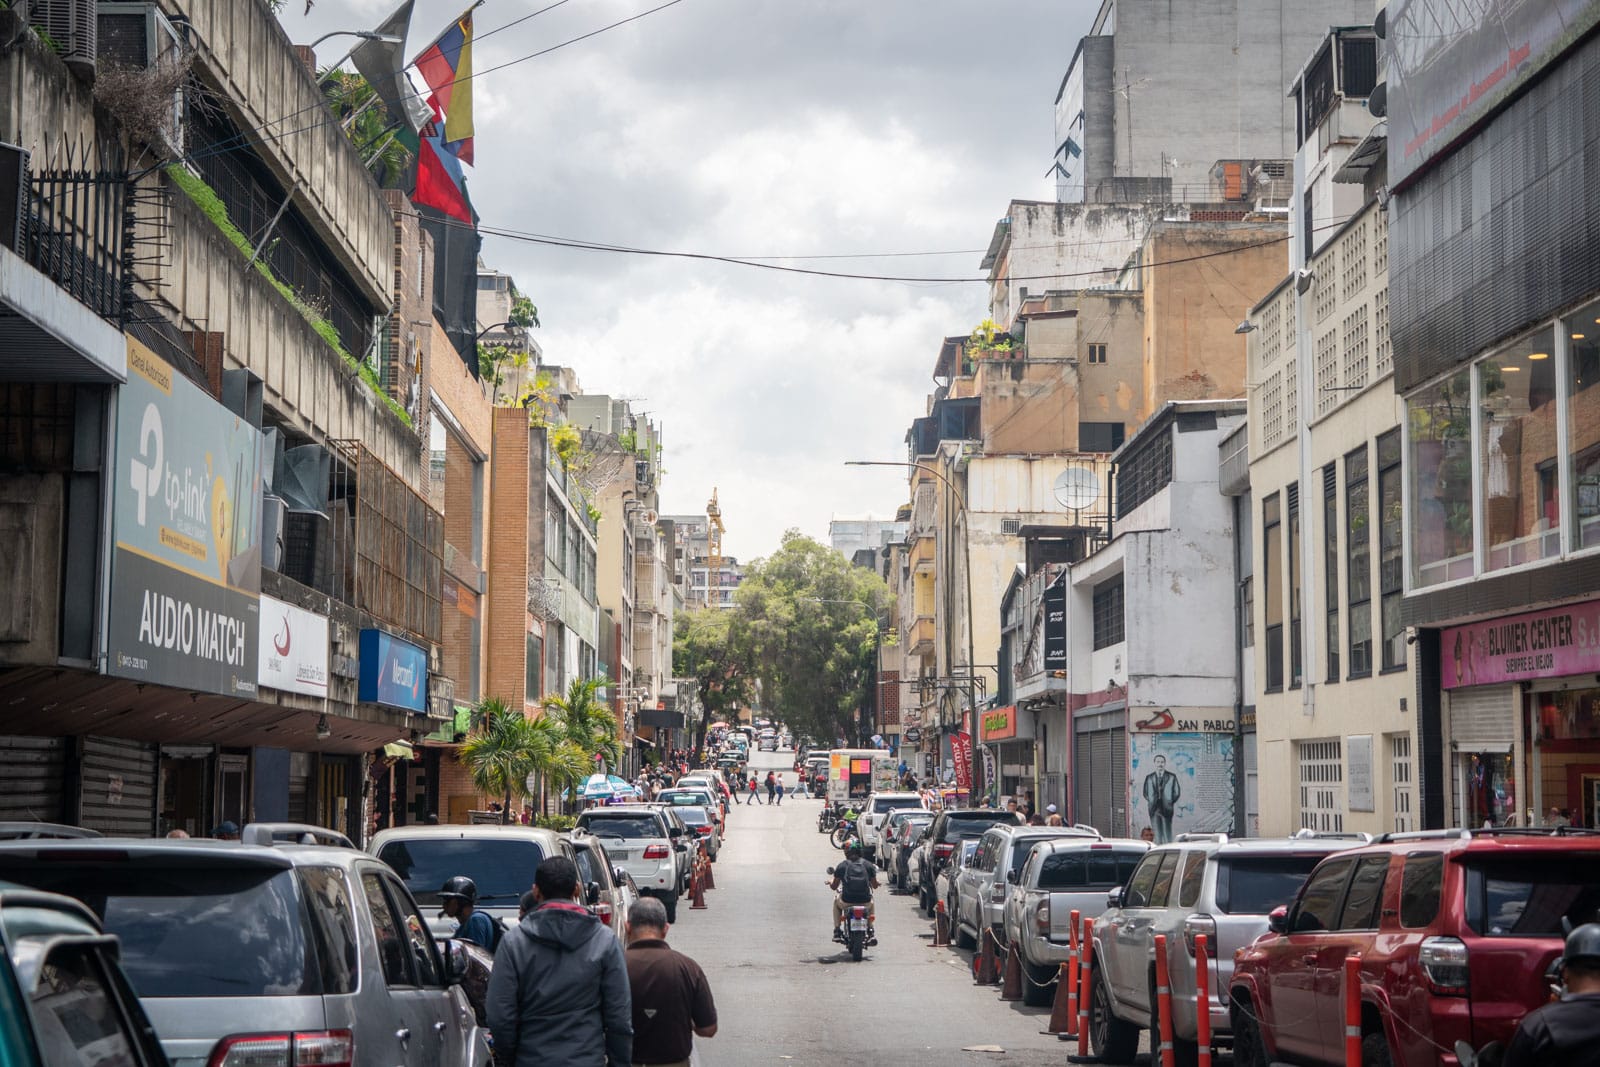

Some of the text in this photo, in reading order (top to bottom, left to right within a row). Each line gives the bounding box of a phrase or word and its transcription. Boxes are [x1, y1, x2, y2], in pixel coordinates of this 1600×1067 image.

[165, 461, 207, 525] tp-link
[139, 589, 245, 667] AUDIO MATCH
[1489, 622, 1528, 656] BLUMER
[1531, 615, 1573, 650] CENTER
[1506, 654, 1554, 673] SIEMPRE EL MEJOR
[1178, 720, 1235, 731] SAN PABLO
